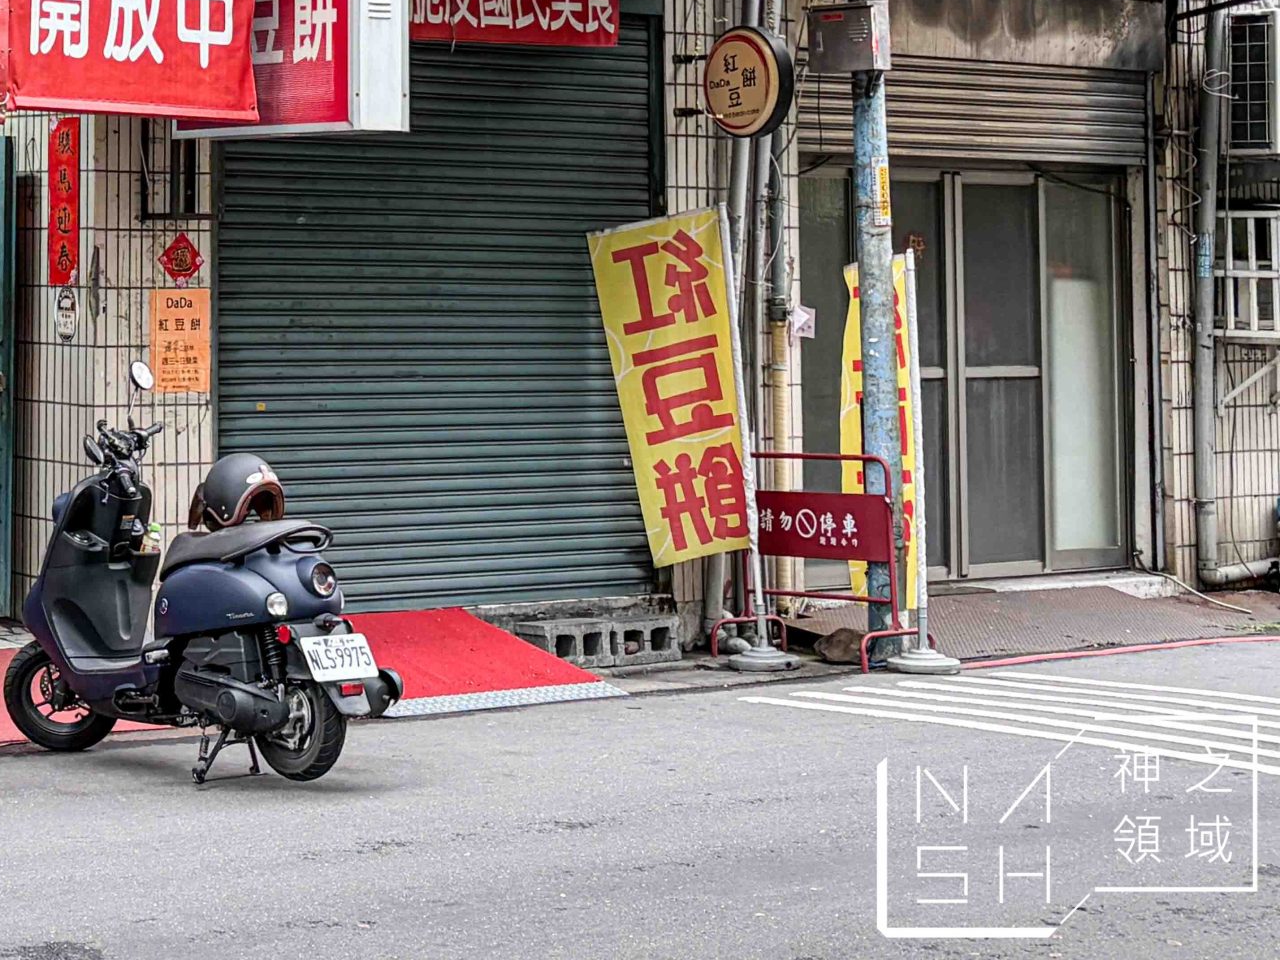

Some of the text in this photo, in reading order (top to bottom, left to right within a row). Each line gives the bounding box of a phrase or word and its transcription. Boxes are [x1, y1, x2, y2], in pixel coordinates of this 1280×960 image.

[709, 79, 731, 89] DaDa
[166, 297, 193, 309] DaDa
[158, 318, 201, 331] 紅豆餅
[760, 507, 857, 537] 請勿 停車
